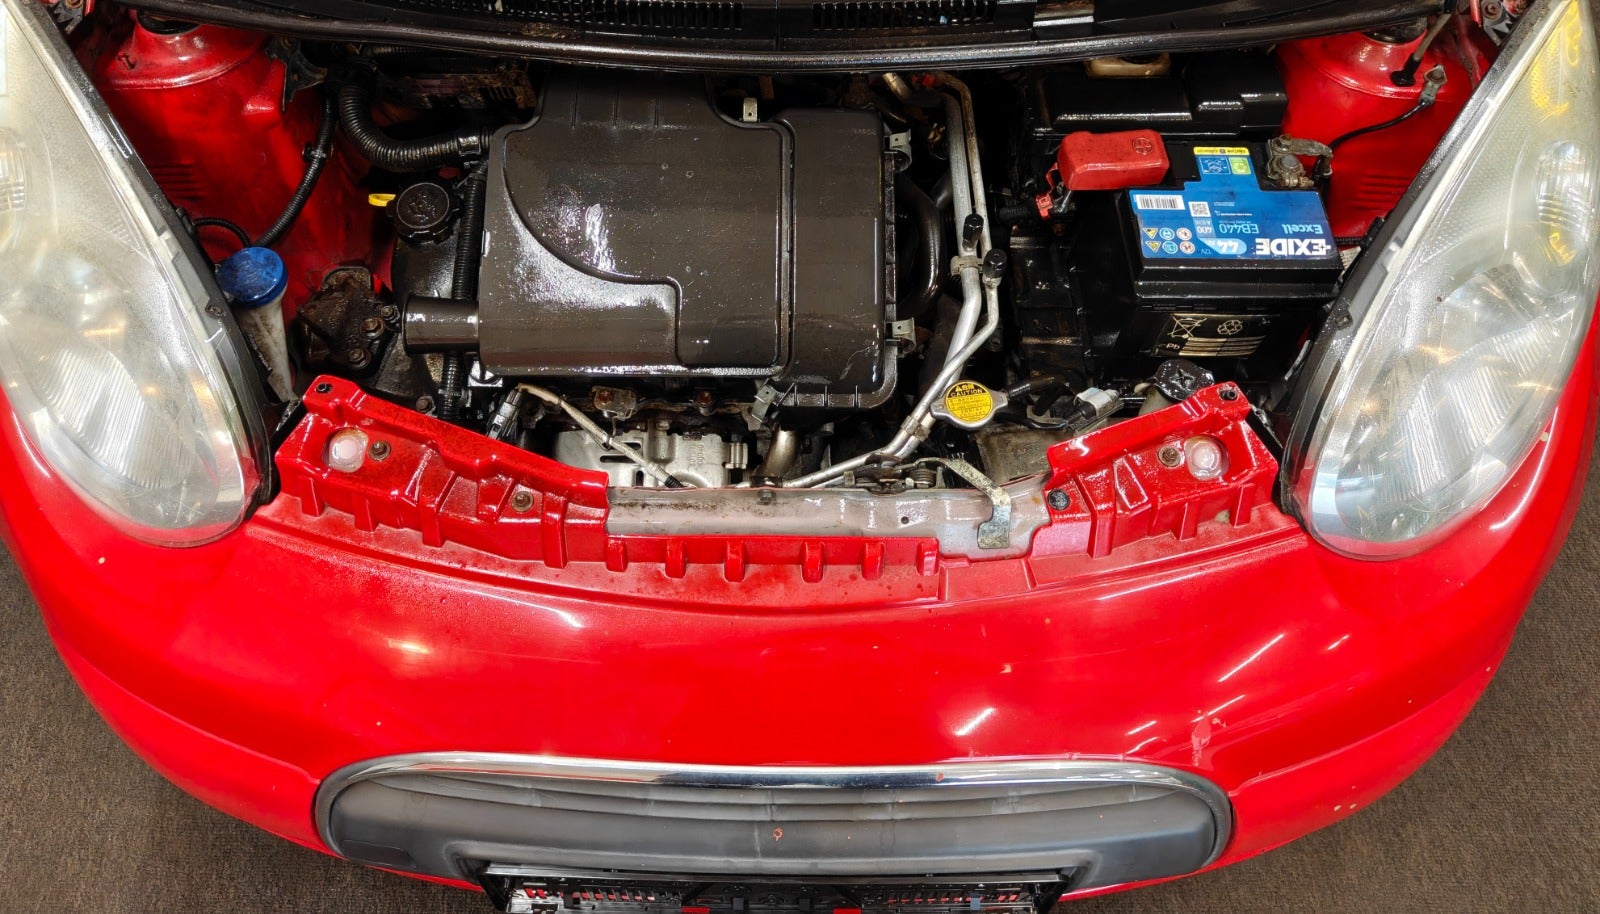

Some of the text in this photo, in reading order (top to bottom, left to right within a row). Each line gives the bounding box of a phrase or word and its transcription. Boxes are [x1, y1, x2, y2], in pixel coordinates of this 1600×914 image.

[1197, 226, 1212, 234] 400
[1219, 223, 1260, 234] EB440
[1281, 223, 1324, 235] Excell
[1217, 240, 1239, 253] 44
[1255, 238, 1331, 256] EXIDE
[950, 388, 983, 397] CAUTION
